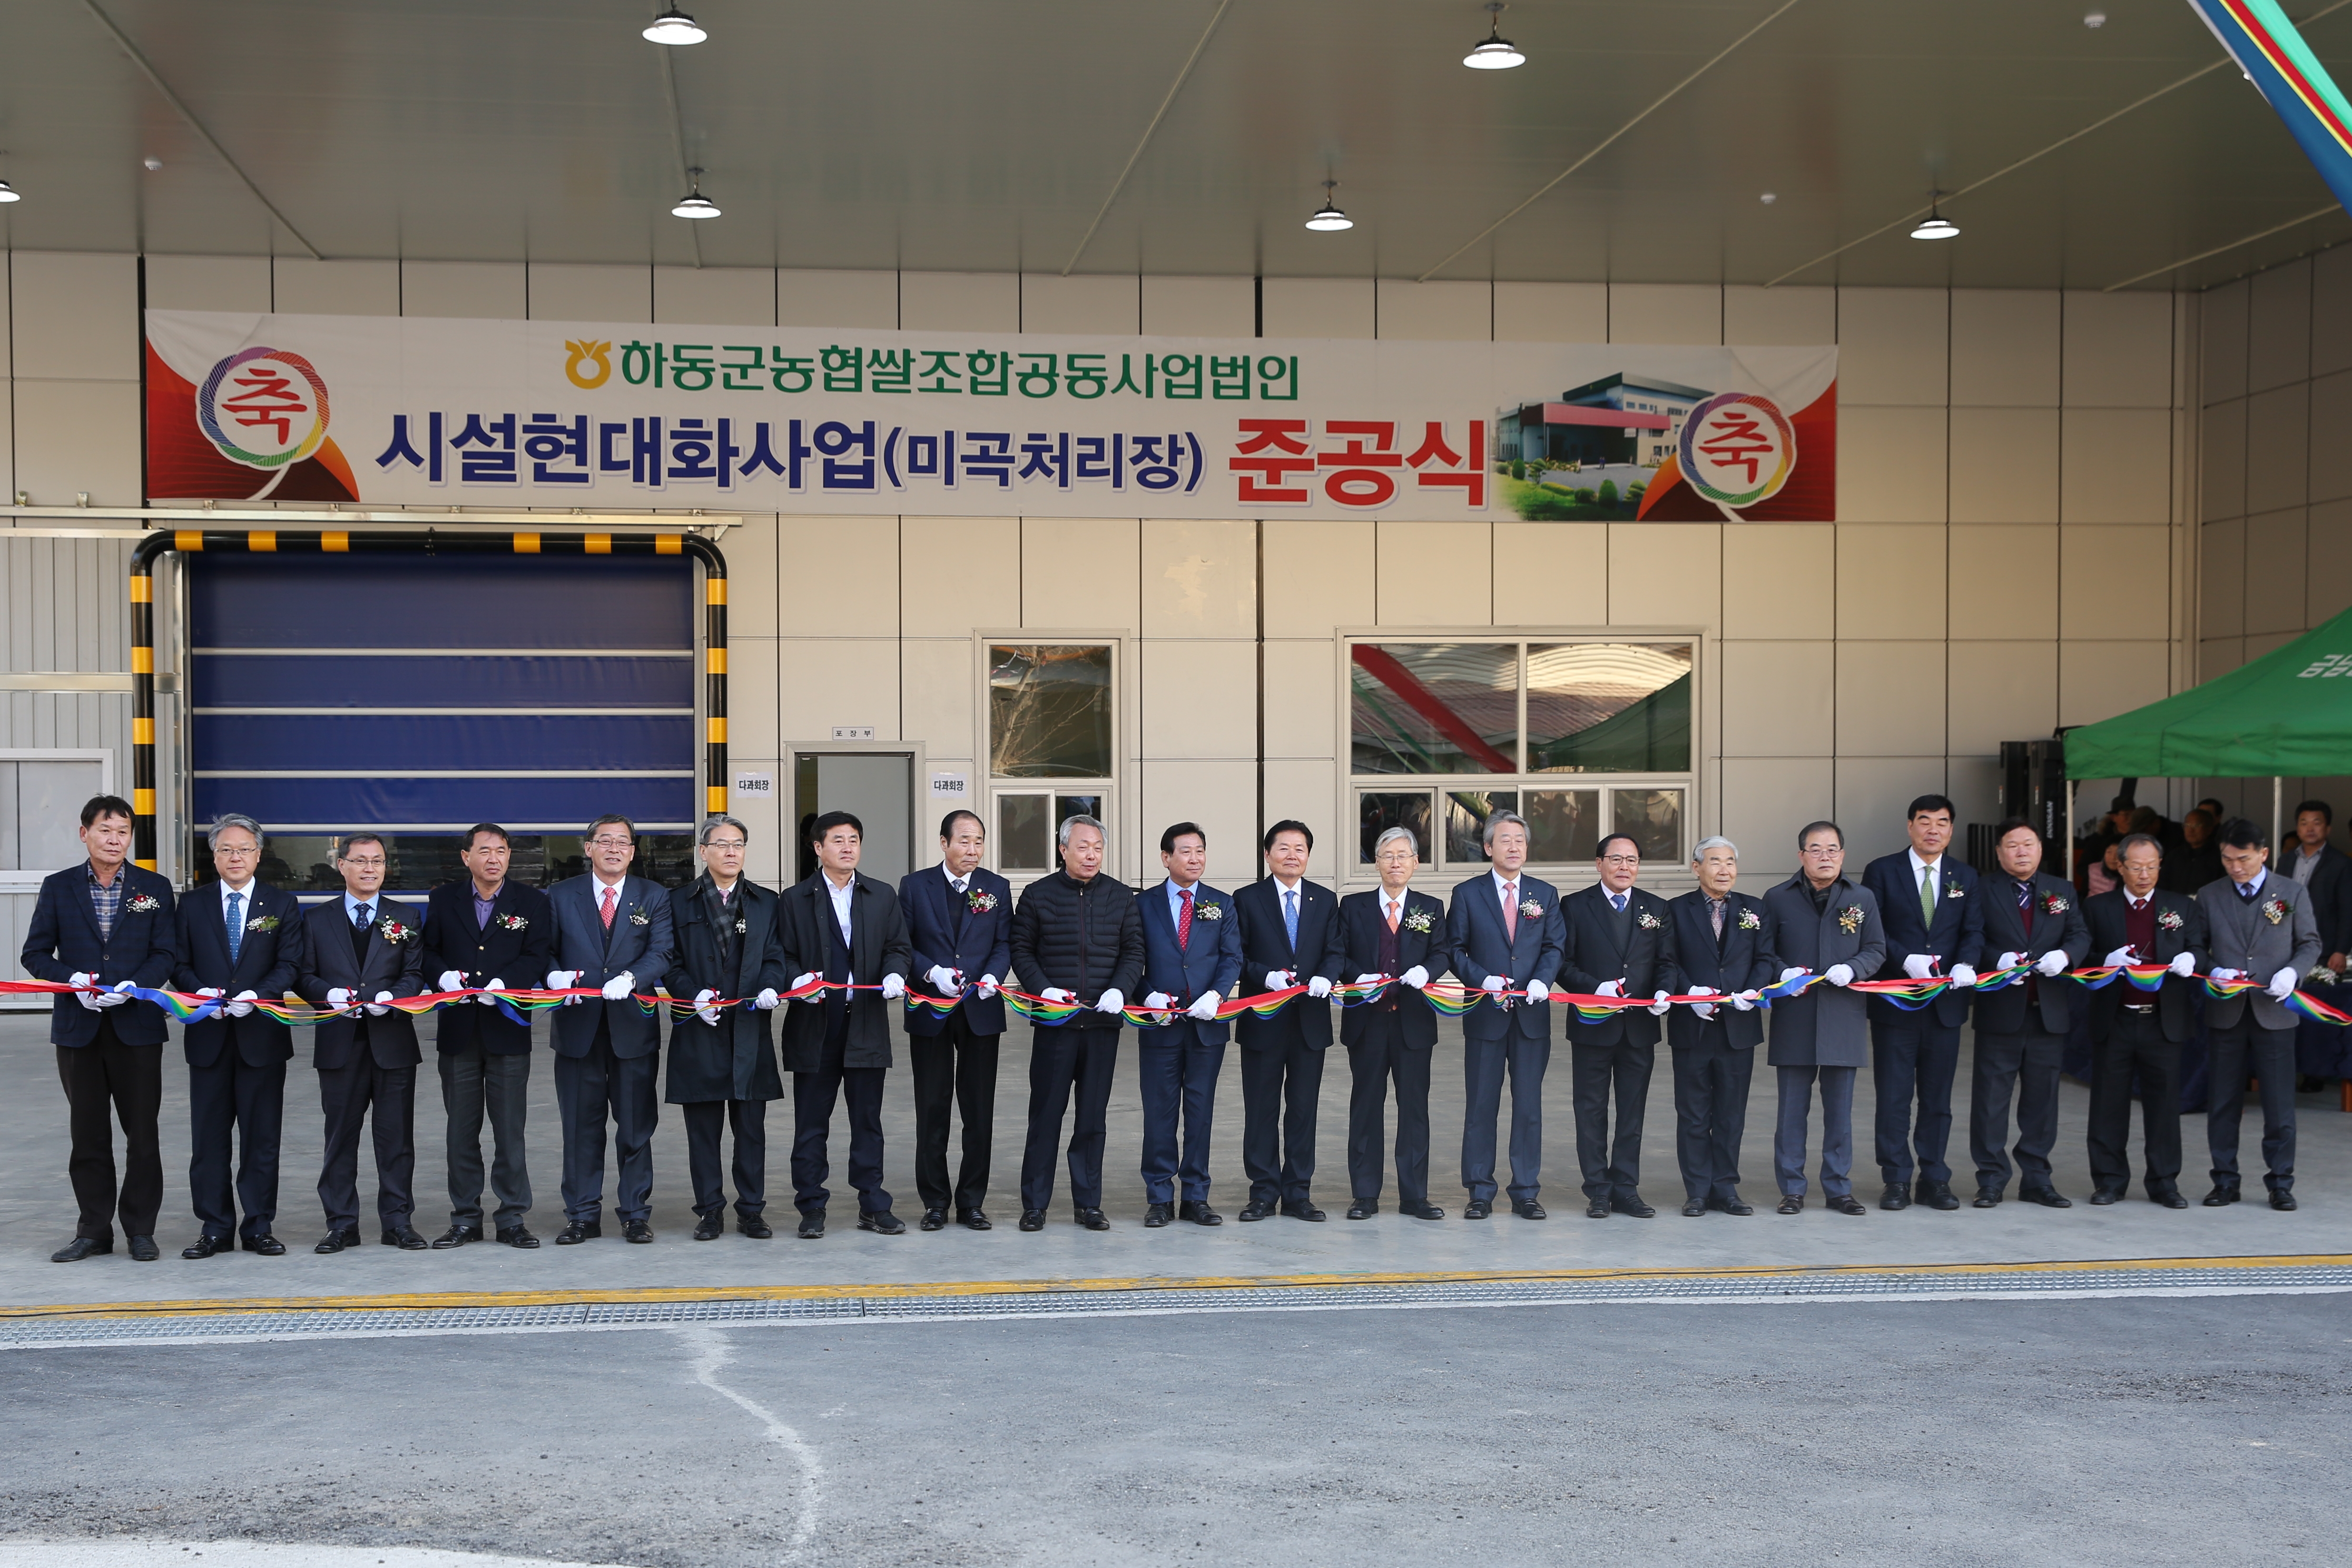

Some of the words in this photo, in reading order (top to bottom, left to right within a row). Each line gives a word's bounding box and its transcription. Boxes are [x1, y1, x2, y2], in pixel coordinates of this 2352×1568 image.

[620, 340, 1298, 401] 하동군농협쌀조합공동사업법인
[221, 367, 308, 445] 축
[375, 412, 1202, 492] 시설현대화사업(미곡처리장)
[1229, 418, 1484, 506] 준공식
[1698, 411, 1774, 484] 축
[739, 779, 769, 791] 다과회장
[934, 780, 964, 791] 다과회장
